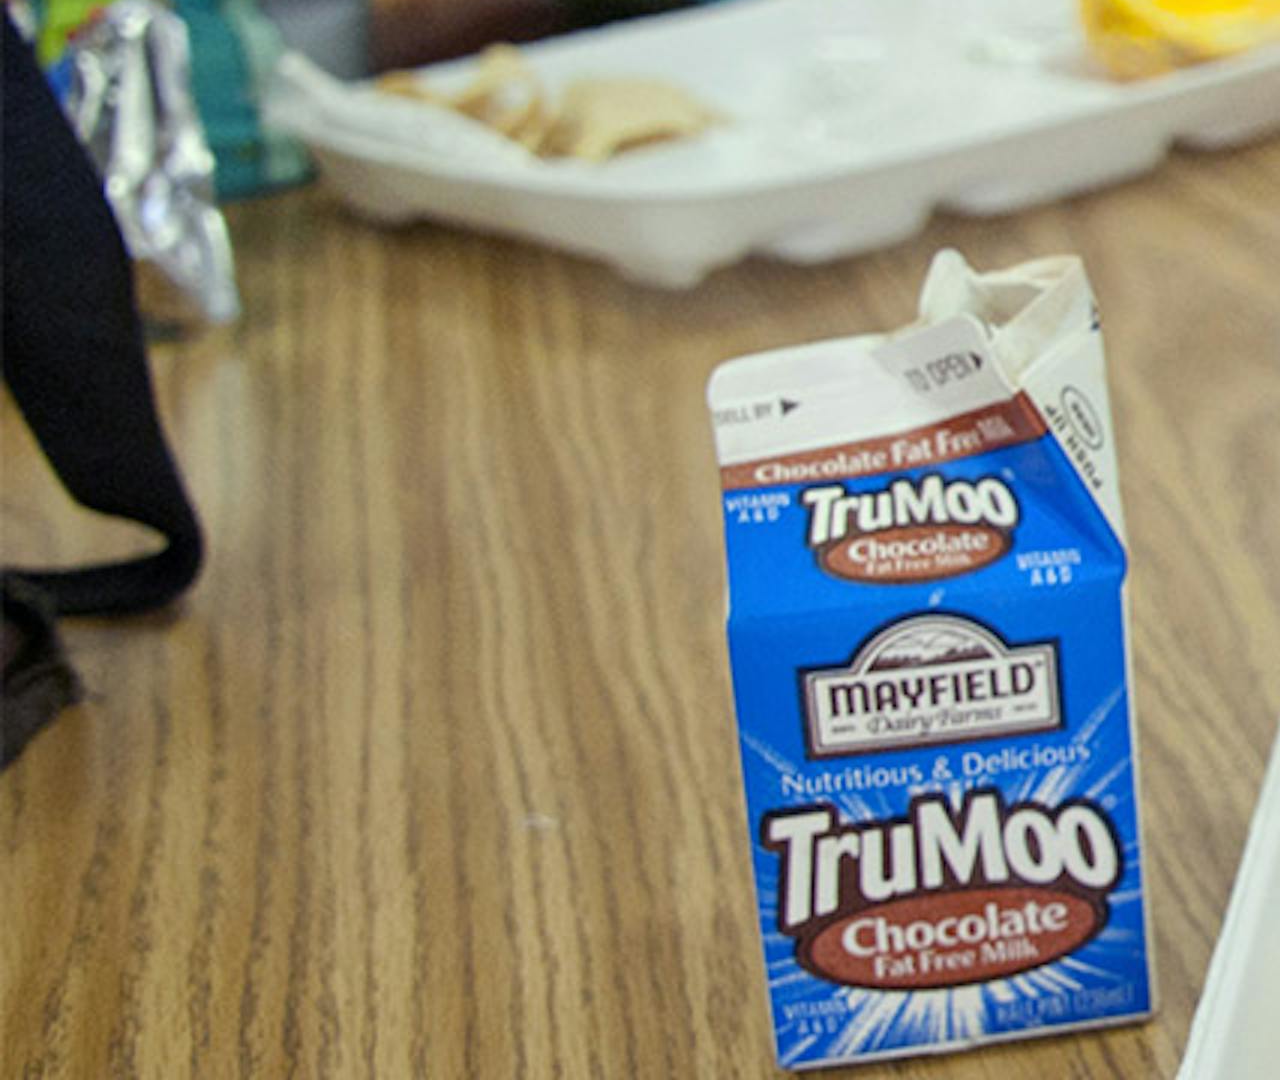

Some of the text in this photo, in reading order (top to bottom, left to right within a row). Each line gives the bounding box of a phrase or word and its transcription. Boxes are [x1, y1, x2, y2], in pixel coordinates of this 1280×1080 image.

[926, 354, 973, 387] OPEN
[754, 451, 887, 483] Chocolate
[890, 438, 932, 466] Fat
[1045, 404, 1104, 491] PUSH UP
[802, 474, 1018, 545] TruMoo
[848, 532, 989, 563] Chocolate
[865, 552, 973, 576] Fat Free Milk
[829, 662, 1035, 717] MAYFIELD
[866, 712, 934, 736] Dairy
[938, 706, 1003, 728] Farms
[781, 741, 1091, 796] Nutritious & Delicious
[768, 793, 1119, 928] TruMoo
[842, 901, 1069, 957] Chocolate
[874, 937, 1039, 979] Fat Free Milk
